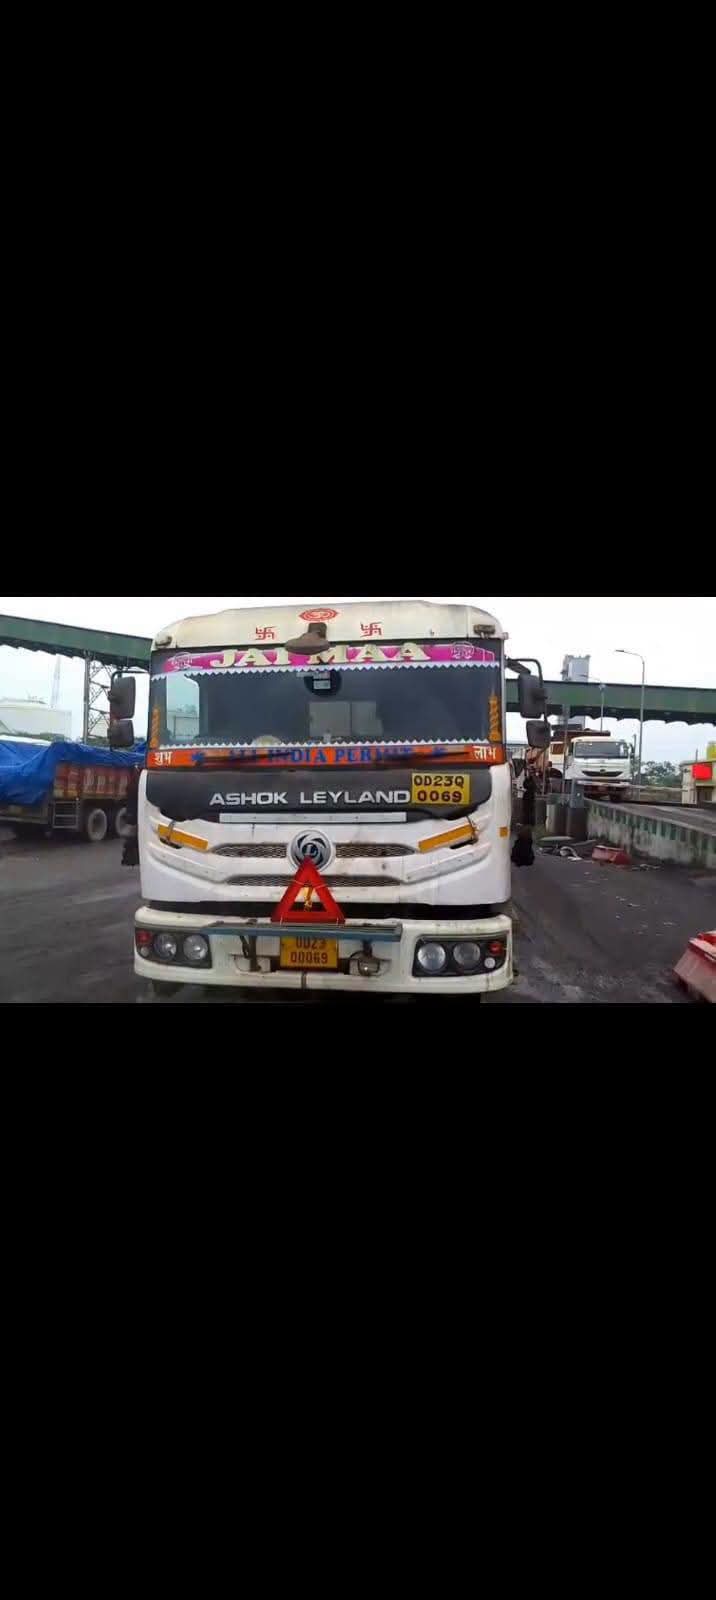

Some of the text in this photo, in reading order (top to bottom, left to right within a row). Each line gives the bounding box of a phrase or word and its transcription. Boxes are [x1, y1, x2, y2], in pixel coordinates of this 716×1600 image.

[210, 642, 431, 668] JAI MAA
[154, 751, 173, 766] शुभ
[473, 745, 497, 760] लाभ
[413, 775, 465, 788] OD23Q
[209, 790, 411, 806] ASHOK LEYLAND
[417, 789, 463, 803] 0069
